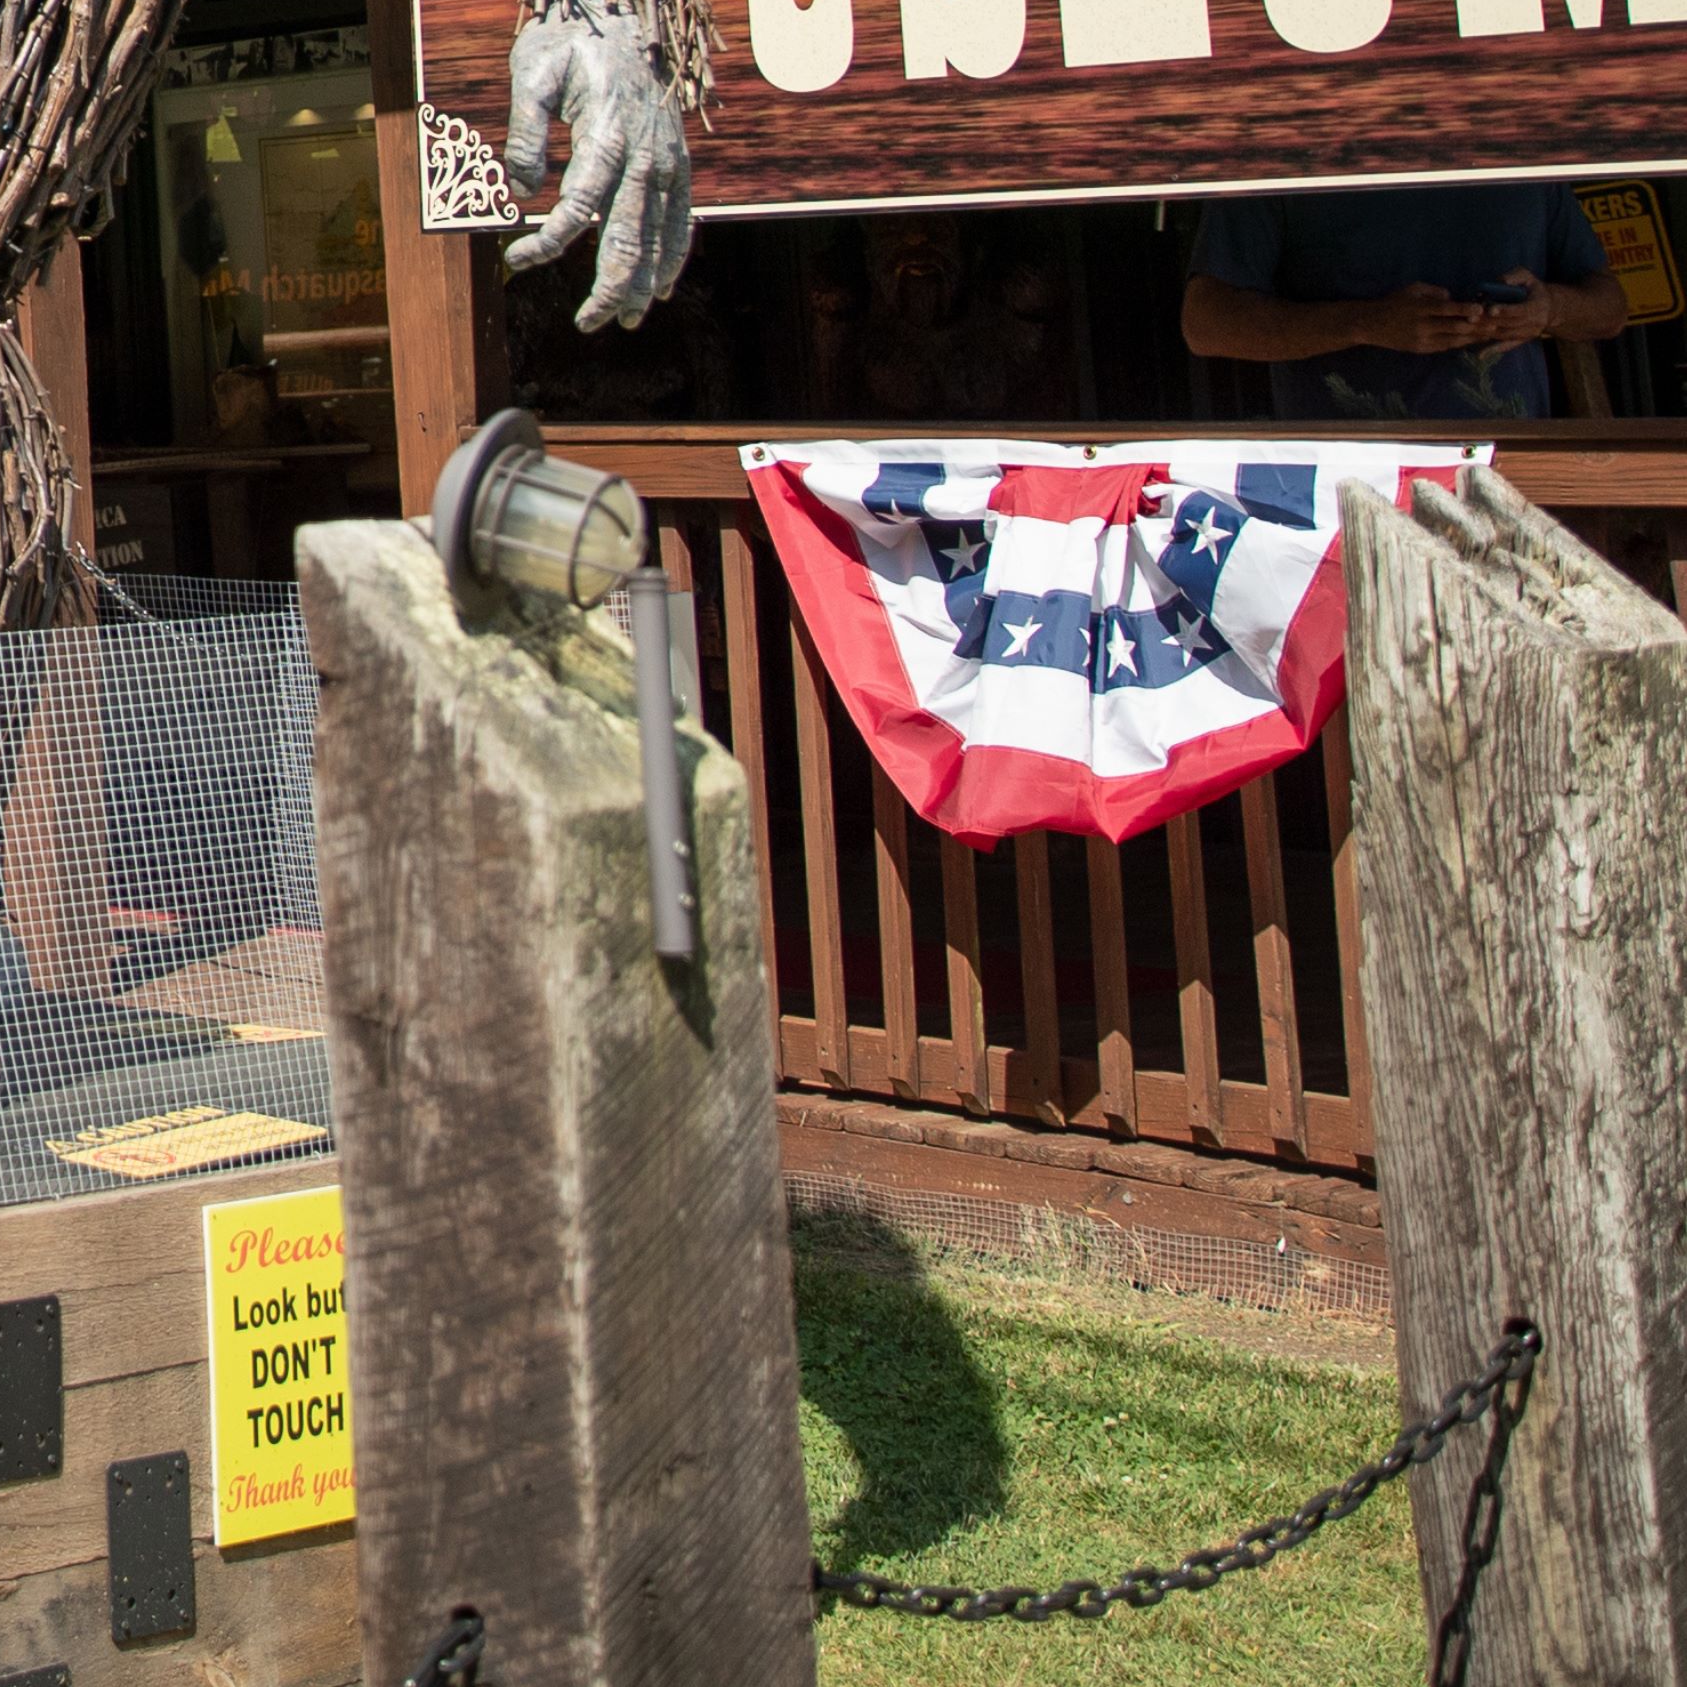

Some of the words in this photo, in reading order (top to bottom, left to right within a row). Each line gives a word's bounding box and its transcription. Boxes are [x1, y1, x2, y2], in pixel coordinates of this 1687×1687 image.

[95, 540, 144, 569] TION
[233, 1287, 298, 1332] Look
[251, 1334, 337, 1389] DON'T
[246, 1392, 345, 1449] TOUCH
[225, 1462, 306, 1513] Thank
[313, 1465, 357, 1507] you
